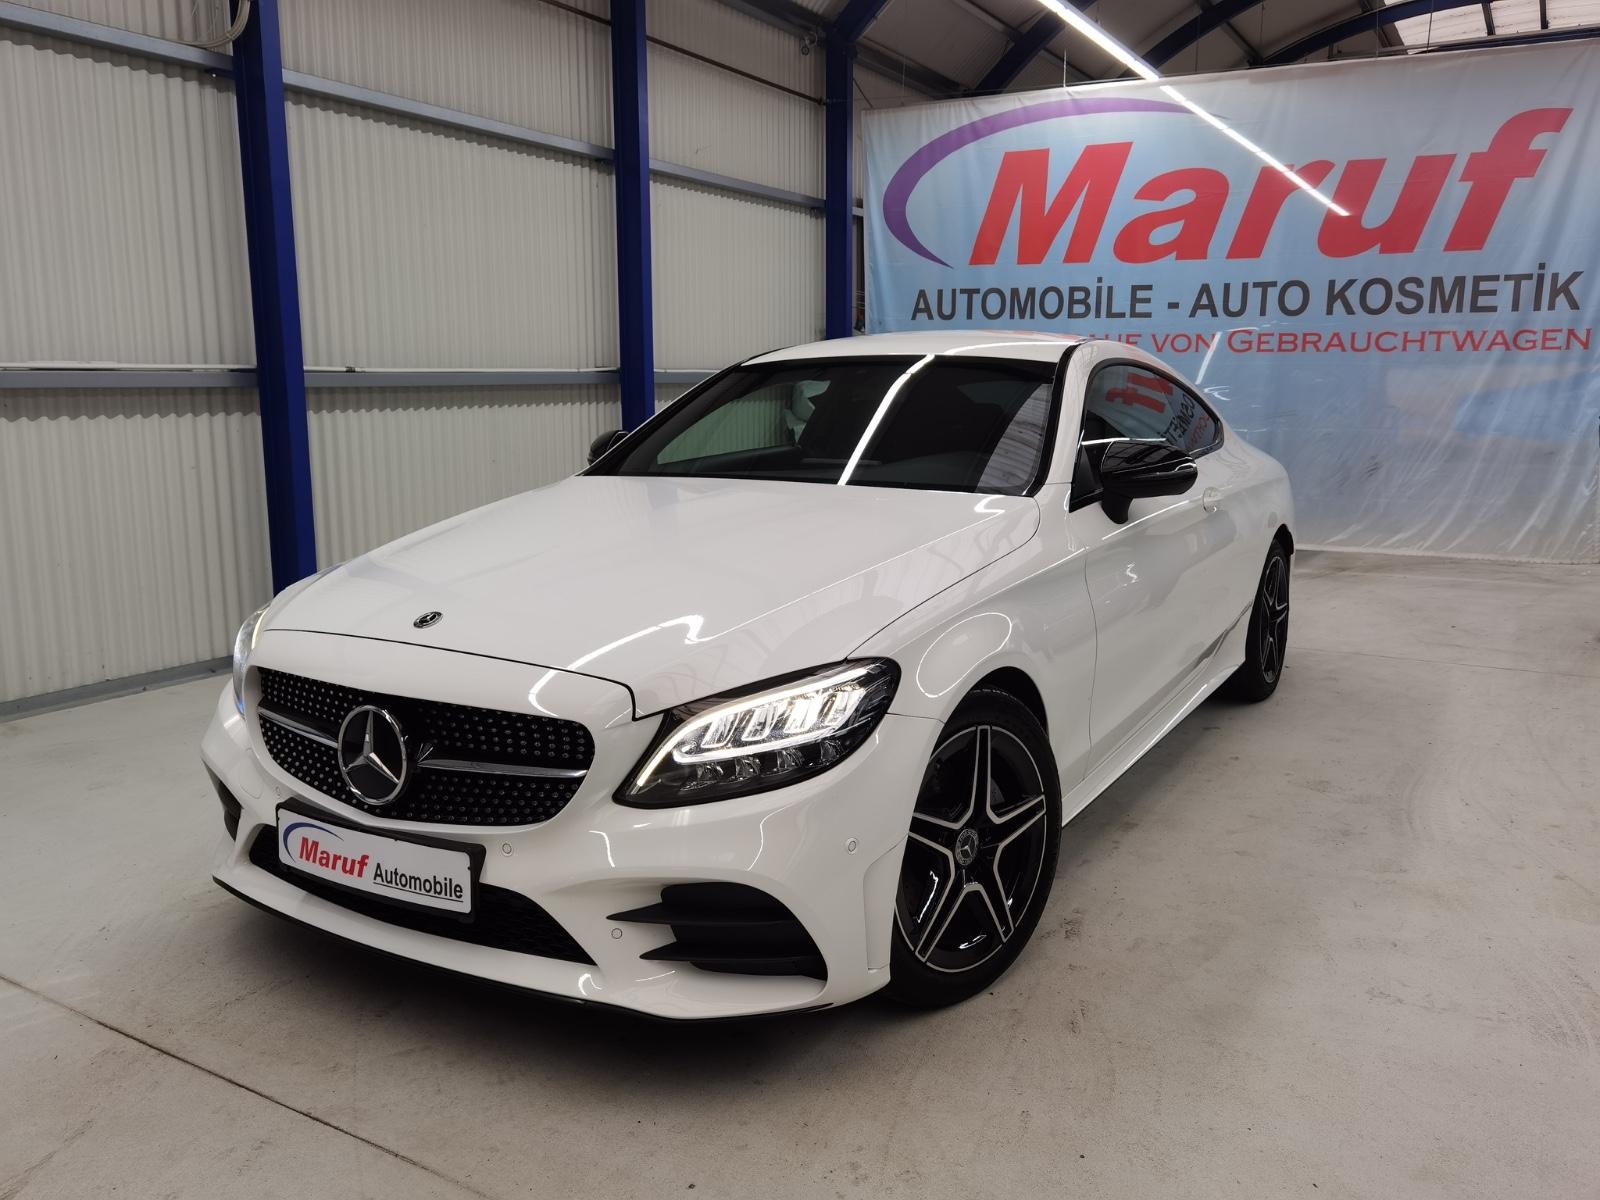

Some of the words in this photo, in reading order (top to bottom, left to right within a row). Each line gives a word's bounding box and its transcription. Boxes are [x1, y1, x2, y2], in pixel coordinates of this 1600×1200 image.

[968, 107, 1574, 266] Maruf
[910, 276, 1154, 321] AUTOMOBİLE
[1188, 279, 1311, 318] AUTO
[1325, 262, 1585, 316] KOSMETİK
[1226, 327, 1593, 354] GEBRAUCHTWAGEN
[298, 835, 370, 879] Maruf
[373, 862, 464, 899] Automobile
